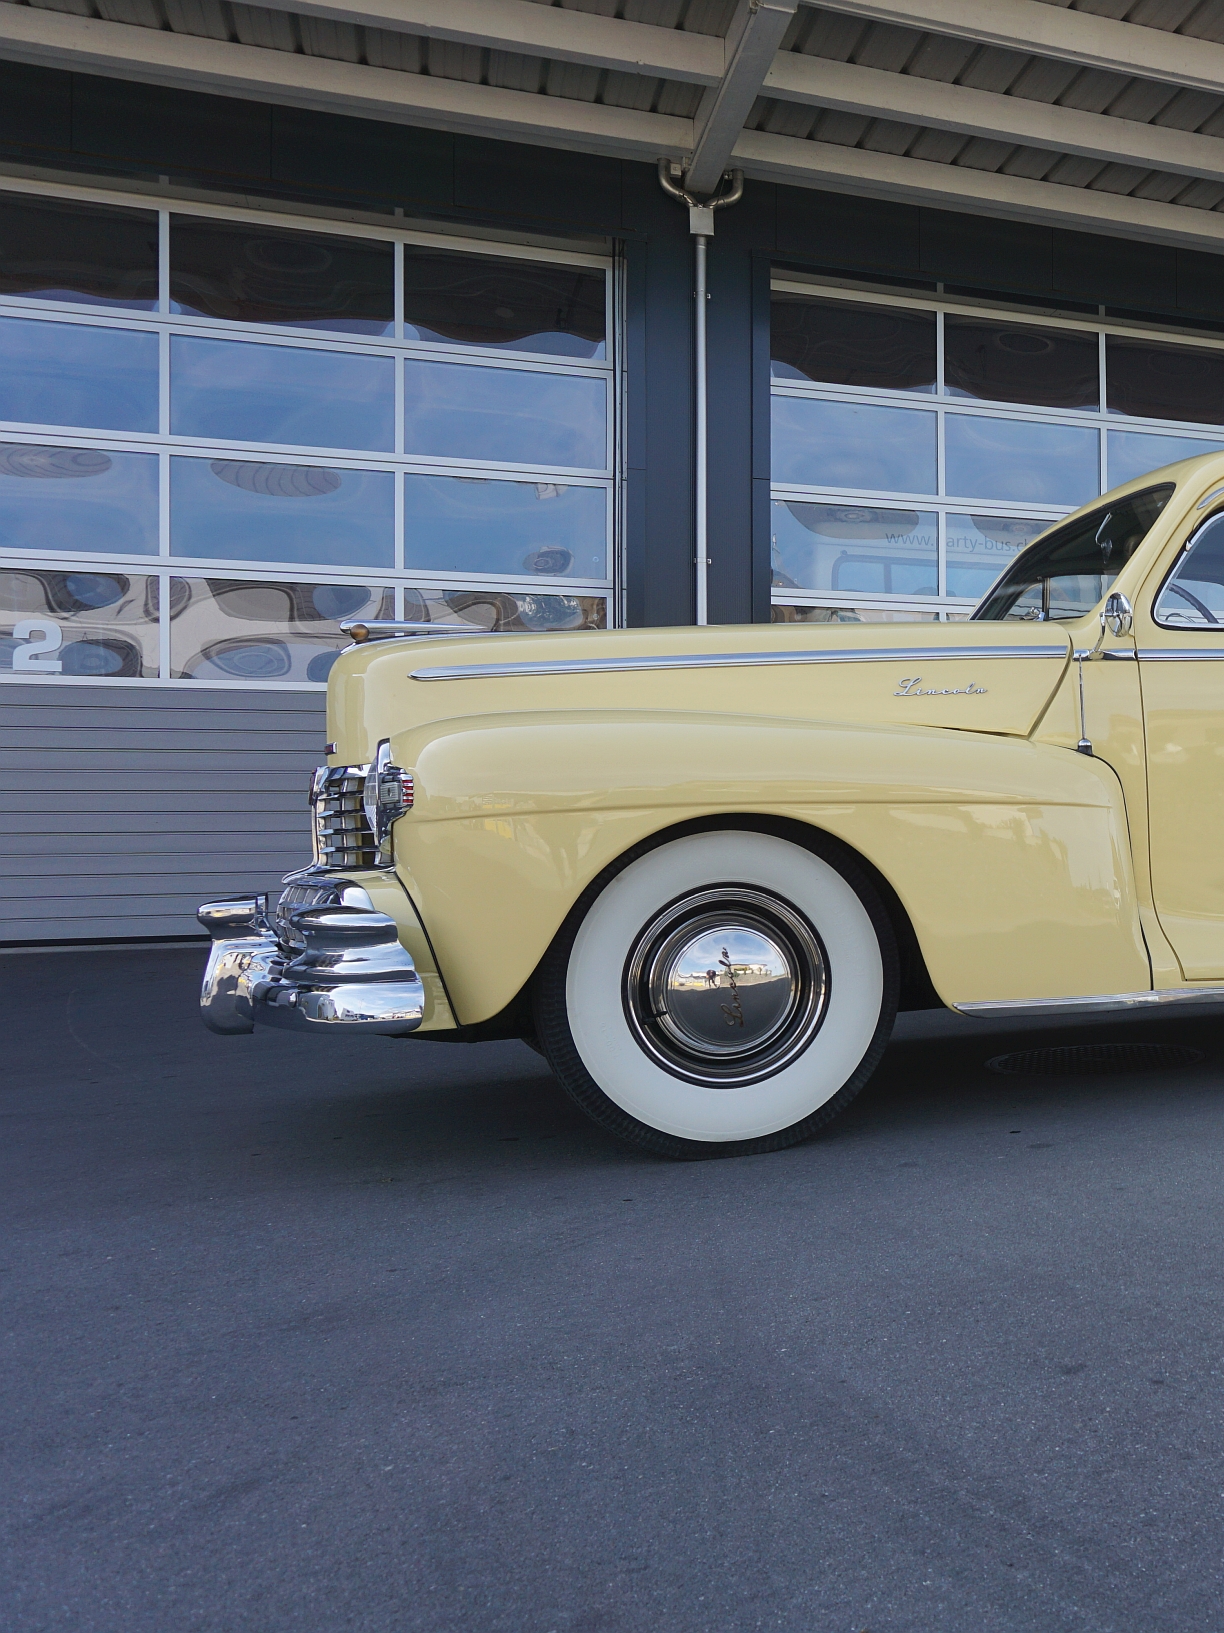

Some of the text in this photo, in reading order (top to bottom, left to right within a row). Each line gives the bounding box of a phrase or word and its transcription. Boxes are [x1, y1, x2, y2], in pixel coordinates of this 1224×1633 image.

[13, 619, 63, 671] 2
[893, 676, 988, 696] Lincoln
[718, 947, 744, 1027] Lincoln
